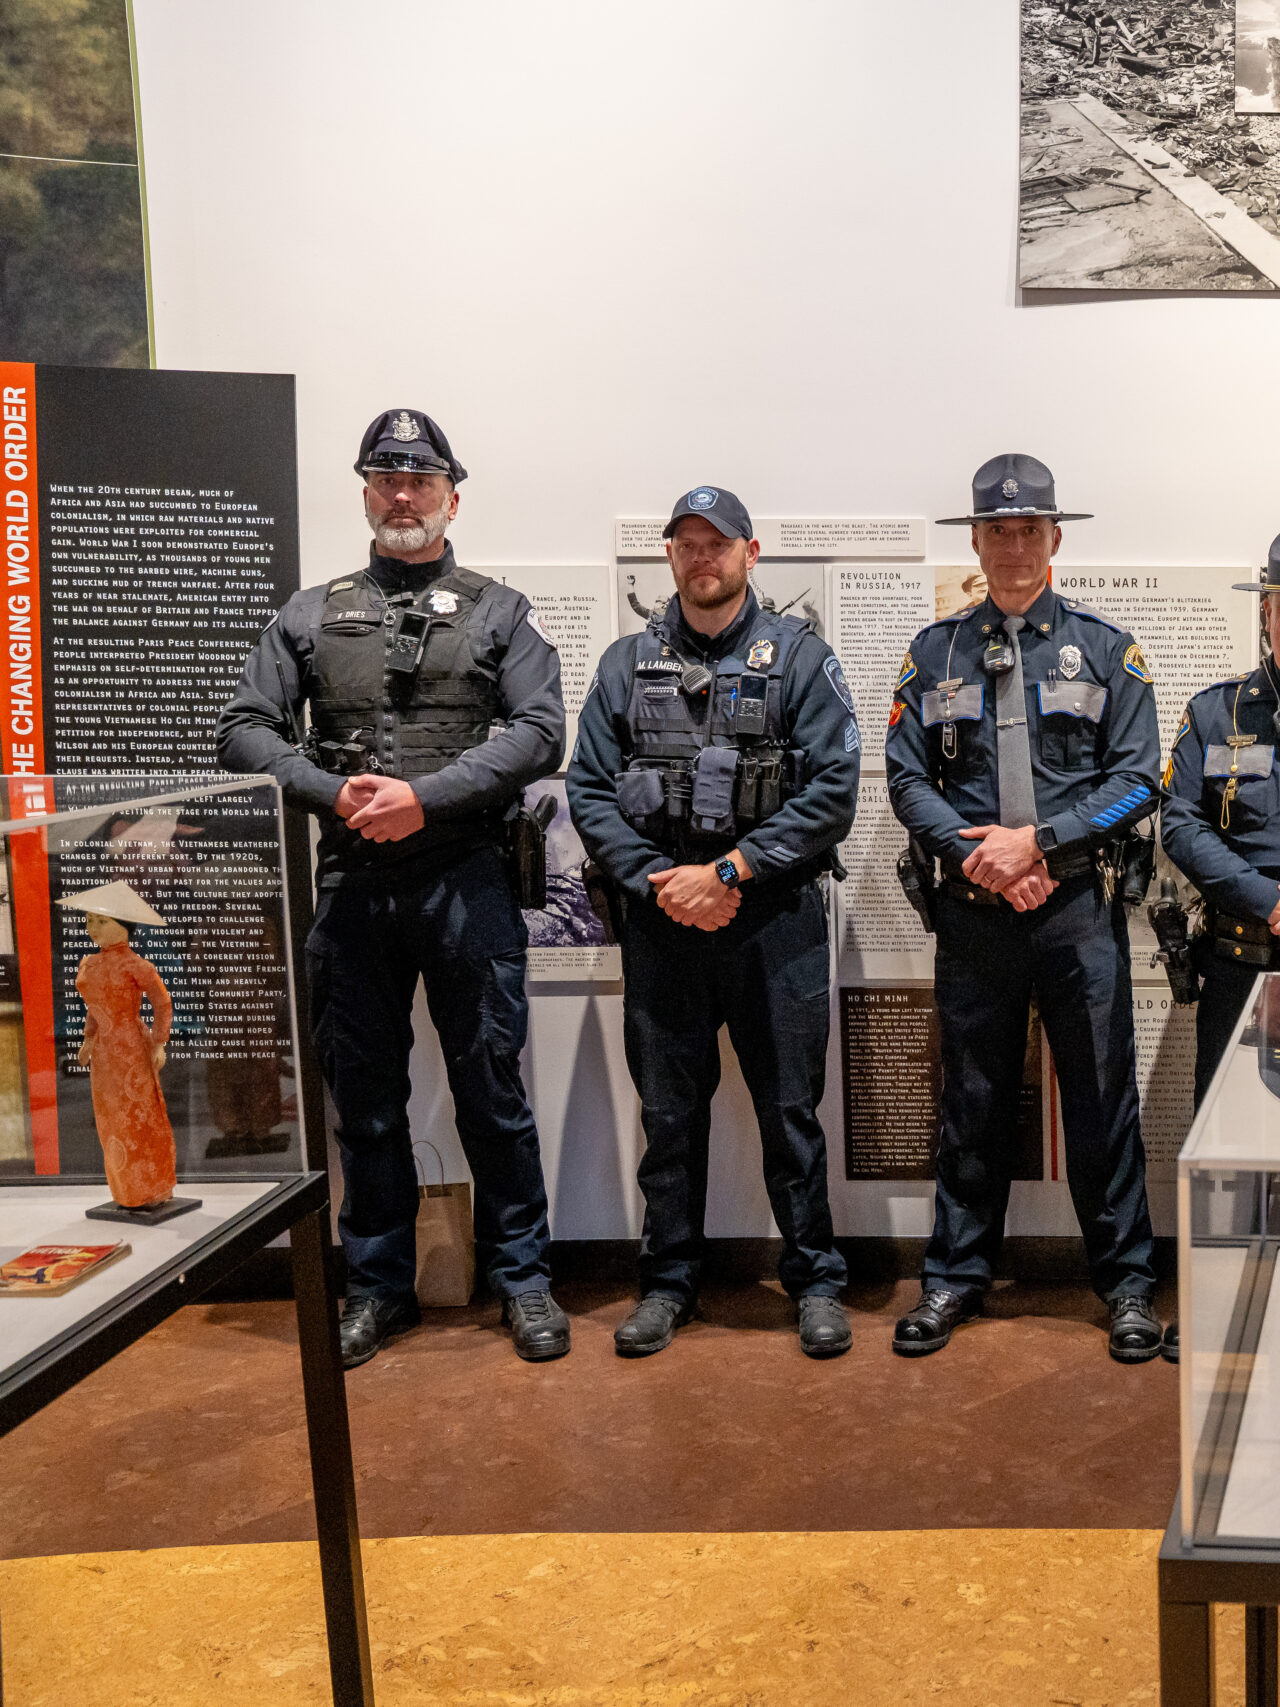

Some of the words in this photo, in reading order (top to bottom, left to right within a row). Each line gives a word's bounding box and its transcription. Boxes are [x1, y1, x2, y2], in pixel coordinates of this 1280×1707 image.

[3, 386, 28, 482] ORDER
[50, 484, 73, 492] WHEN
[164, 489, 194, 497] BEGAN,
[50, 497, 81, 505] AFRICA
[105, 499, 125, 507] ASIA
[149, 501, 196, 509] SUCCUMBED
[215, 502, 257, 510] EUROPEAN
[50, 512, 112, 521] COLONIALISM,
[178, 515, 223, 523] MATERIALS
[51, 525, 109, 533] POPULATIONS
[208, 529, 259, 537] COMMERCIAL
[6, 489, 30, 587] WORLD
[856, 582, 894, 590] RUSSIA,
[1060, 577, 1105, 587] WORLD
[1113, 578, 1137, 587] WAR
[1146, 578, 1157, 587] II
[8, 594, 33, 735] CHANGING
[647, 660, 684, 673] LAMBER
[12, 743, 34, 776] HE
[60, 839, 70, 848] IN
[74, 840, 115, 848] COLONIAL
[118, 839, 158, 849] VIETNAM,
[161, 840, 175, 848] THE
[60, 852, 96, 860] CHANGES
[169, 853, 193, 861] SORT.
[1160, 1000, 1195, 1009] ORDE
